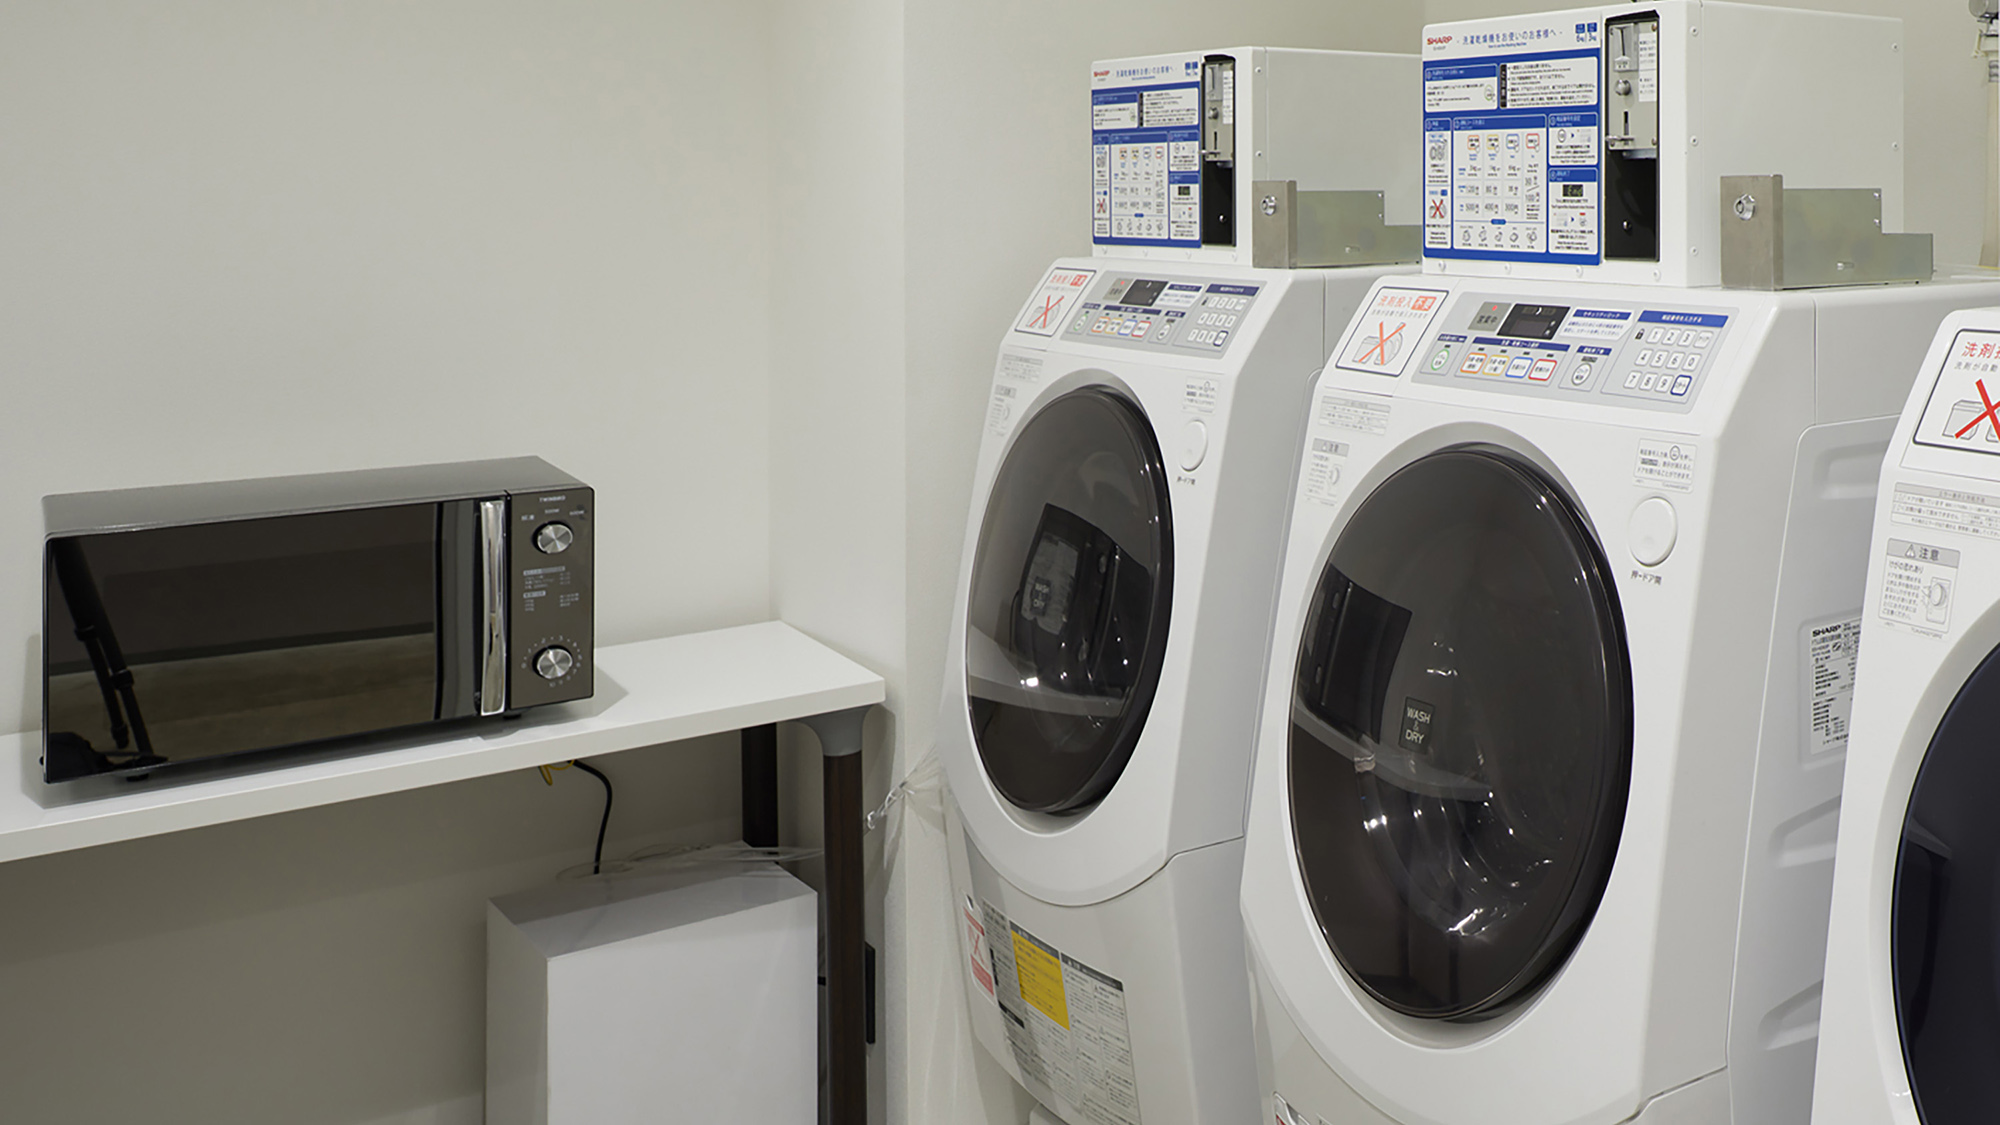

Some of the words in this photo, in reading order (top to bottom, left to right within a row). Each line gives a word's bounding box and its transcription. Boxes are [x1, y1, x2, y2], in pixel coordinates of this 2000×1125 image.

[1427, 35, 1453, 45] SHARP
[1918, 546, 1940, 561] 注意
[1812, 624, 1842, 638] SHARP
[1407, 706, 1431, 724] WASH
[1405, 729, 1425, 744] DRY
